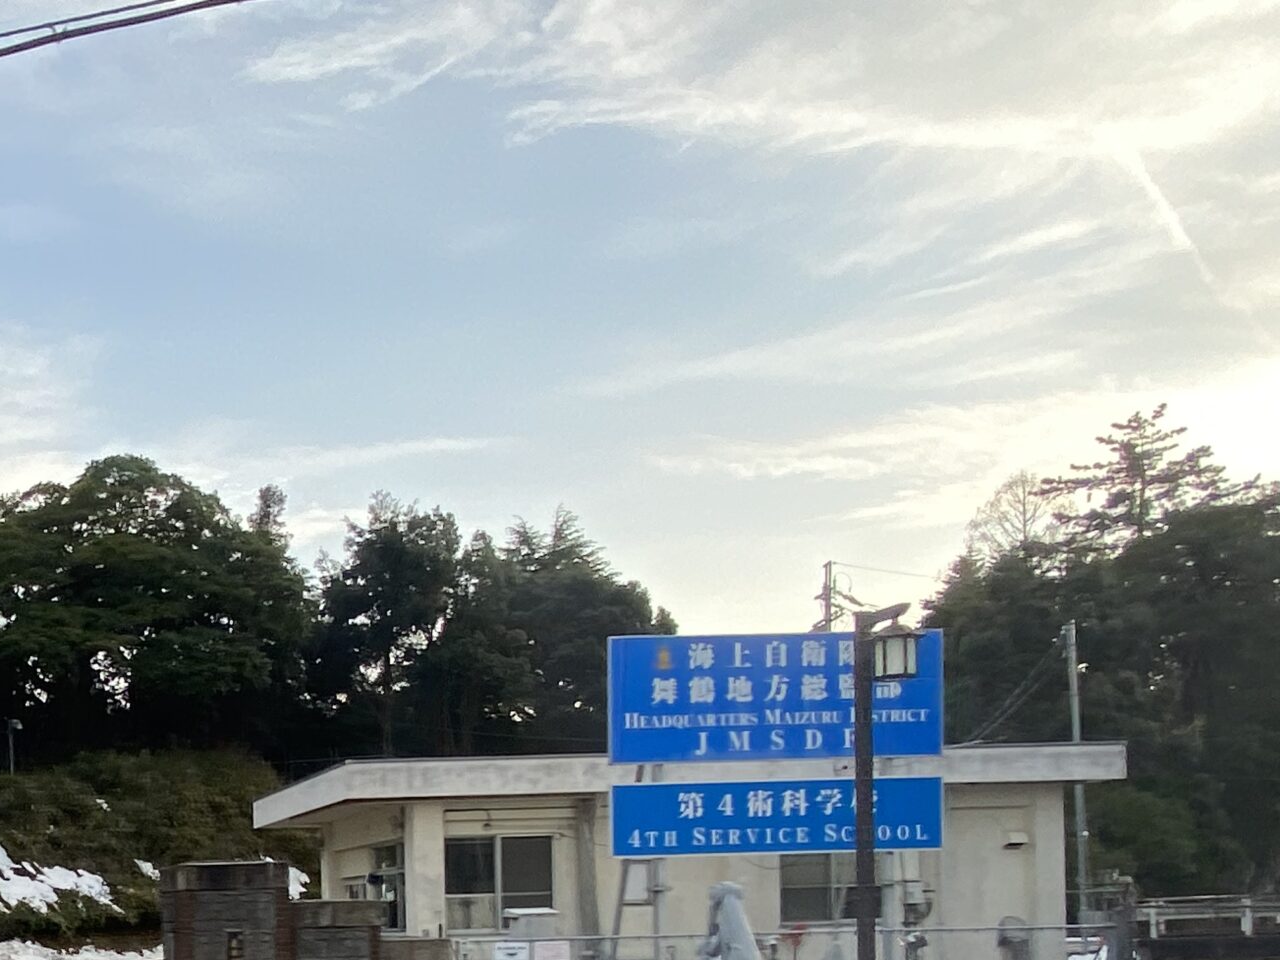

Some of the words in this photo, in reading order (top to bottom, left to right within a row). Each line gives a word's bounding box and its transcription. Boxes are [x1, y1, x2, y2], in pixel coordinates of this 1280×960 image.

[624, 712, 758, 729] HEADQUARTERS
[765, 707, 842, 725] MAIZURU
[628, 828, 678, 848] 4TH
[693, 825, 809, 846] SERVICE
[824, 823, 928, 843] SCOOL
